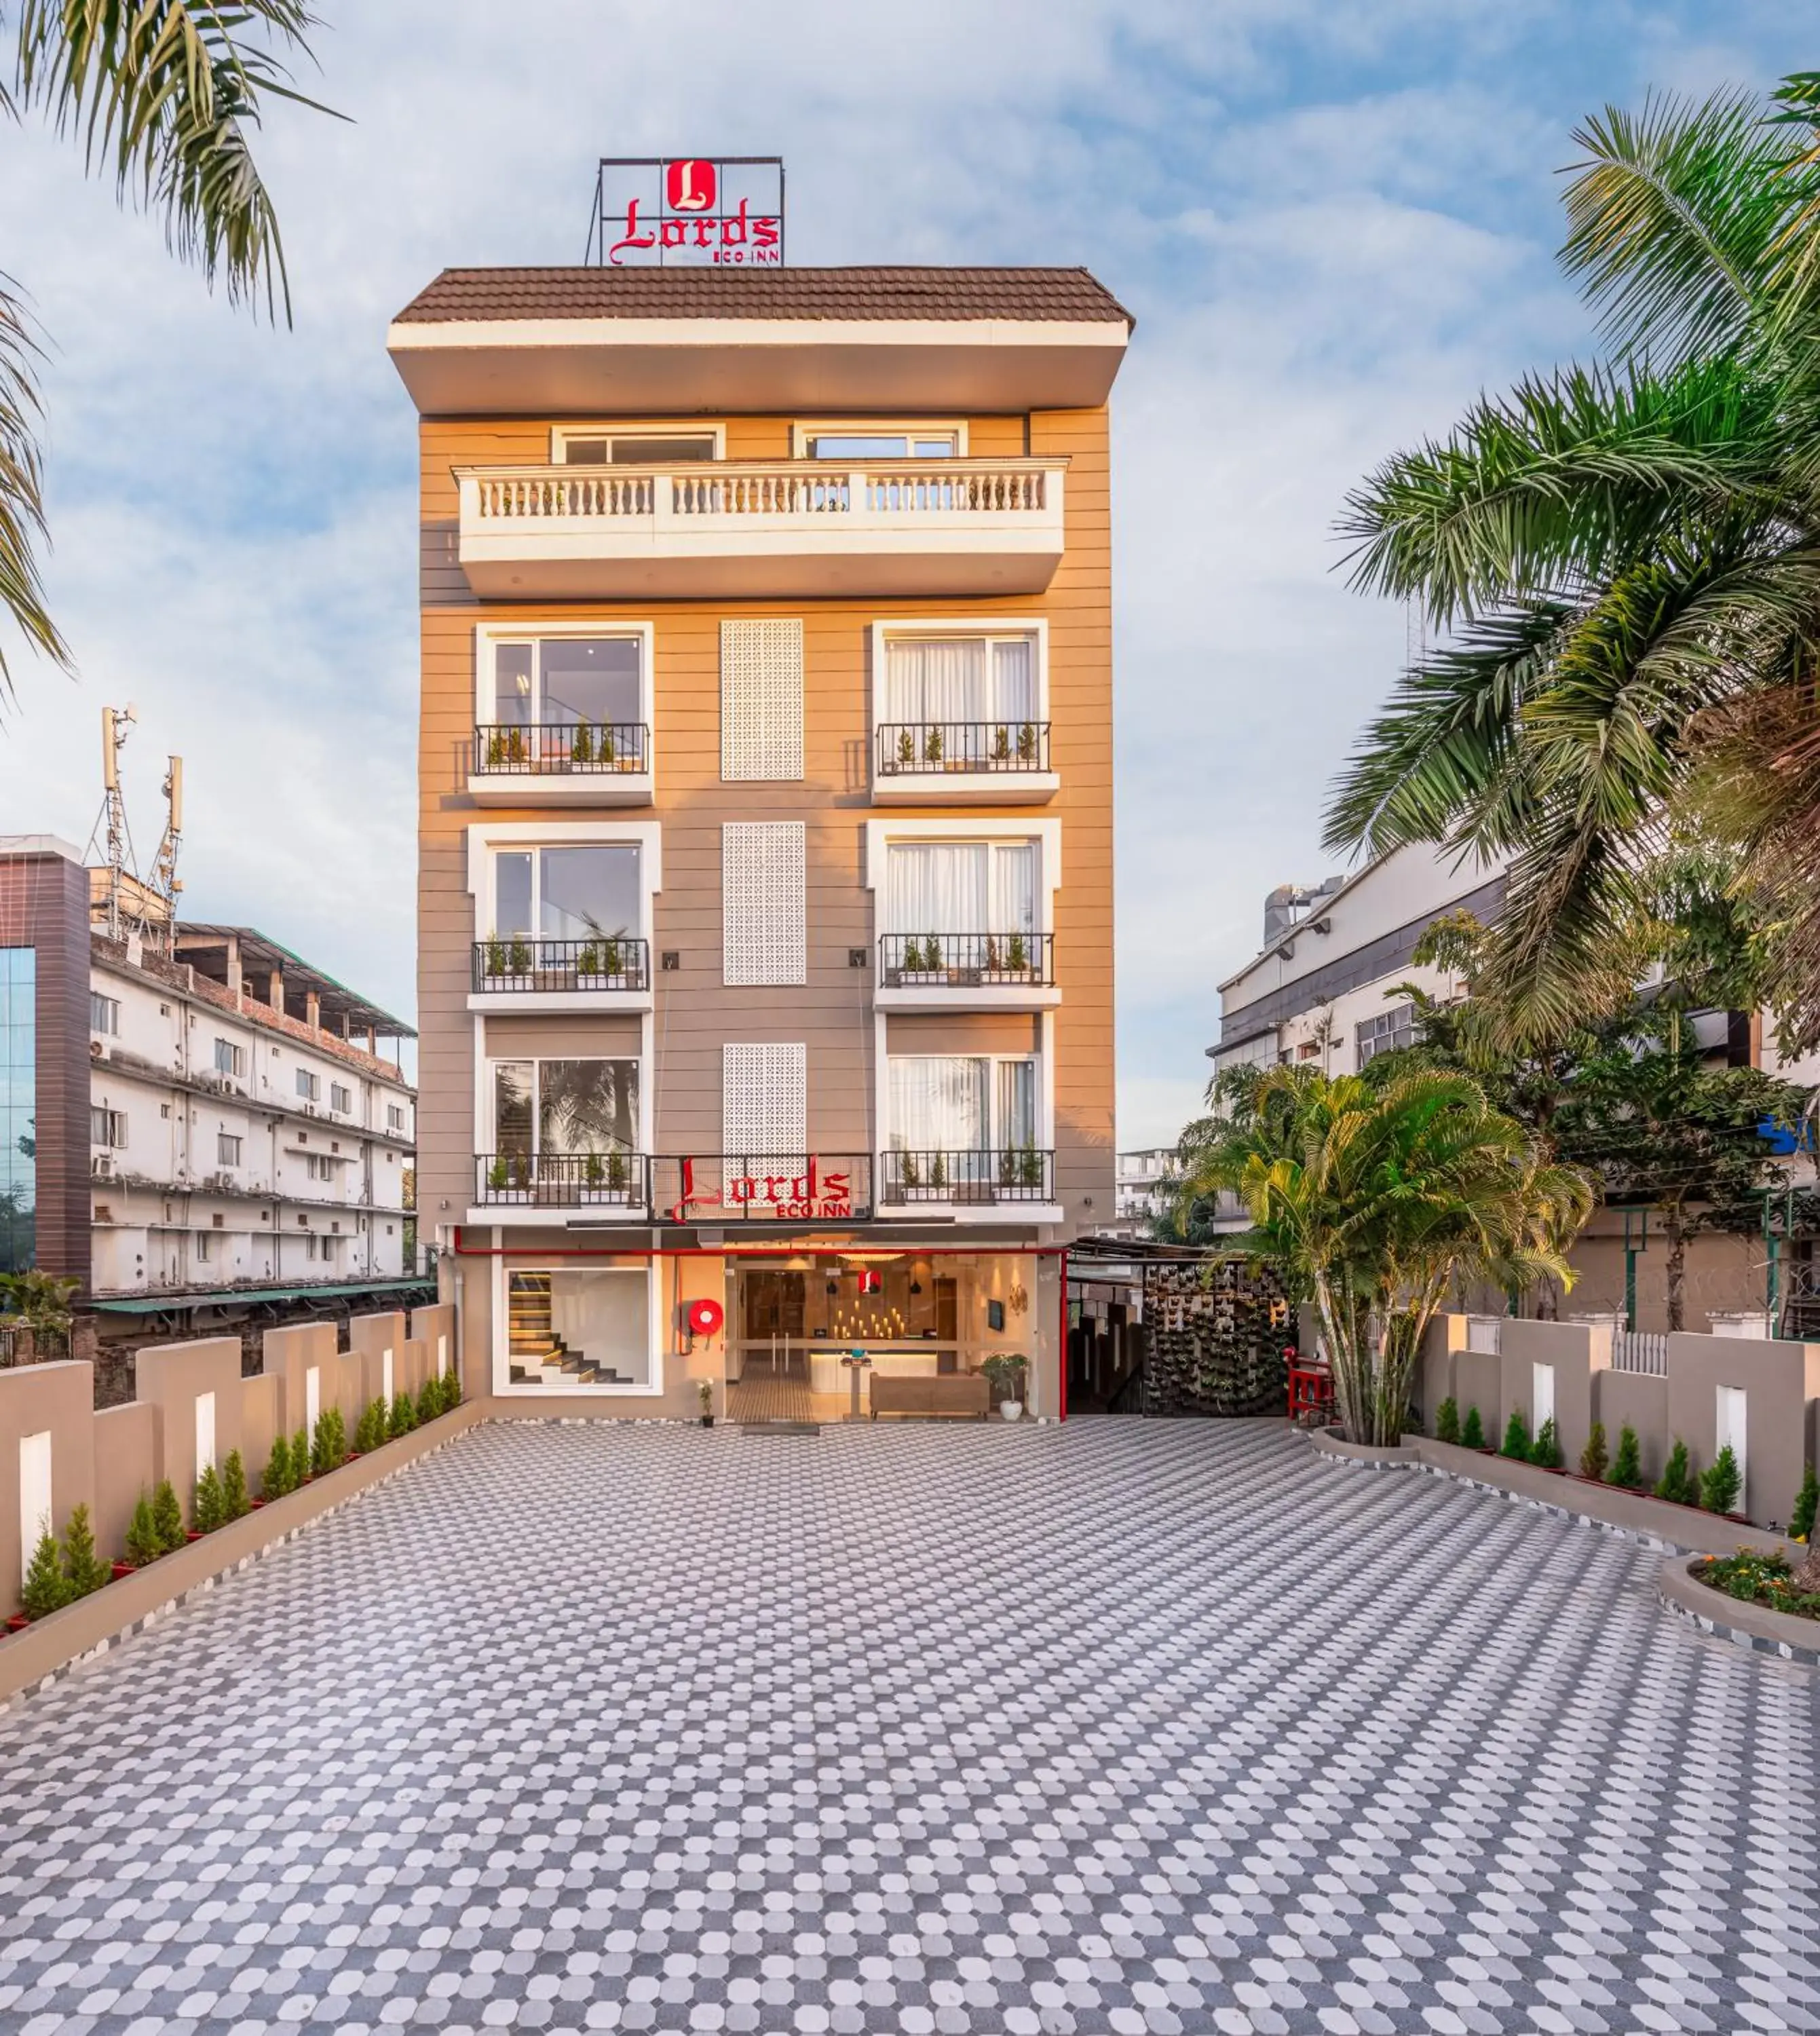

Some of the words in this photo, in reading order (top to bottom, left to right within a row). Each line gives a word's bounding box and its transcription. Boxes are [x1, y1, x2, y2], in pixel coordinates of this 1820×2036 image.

[674, 160, 706, 210] L
[609, 198, 778, 265] Lords
[713, 250, 743, 263] ECO
[751, 250, 778, 263] INN
[672, 1154, 850, 1225] Lords
[776, 1203, 813, 1218] ECO
[818, 1203, 851, 1217] INN
